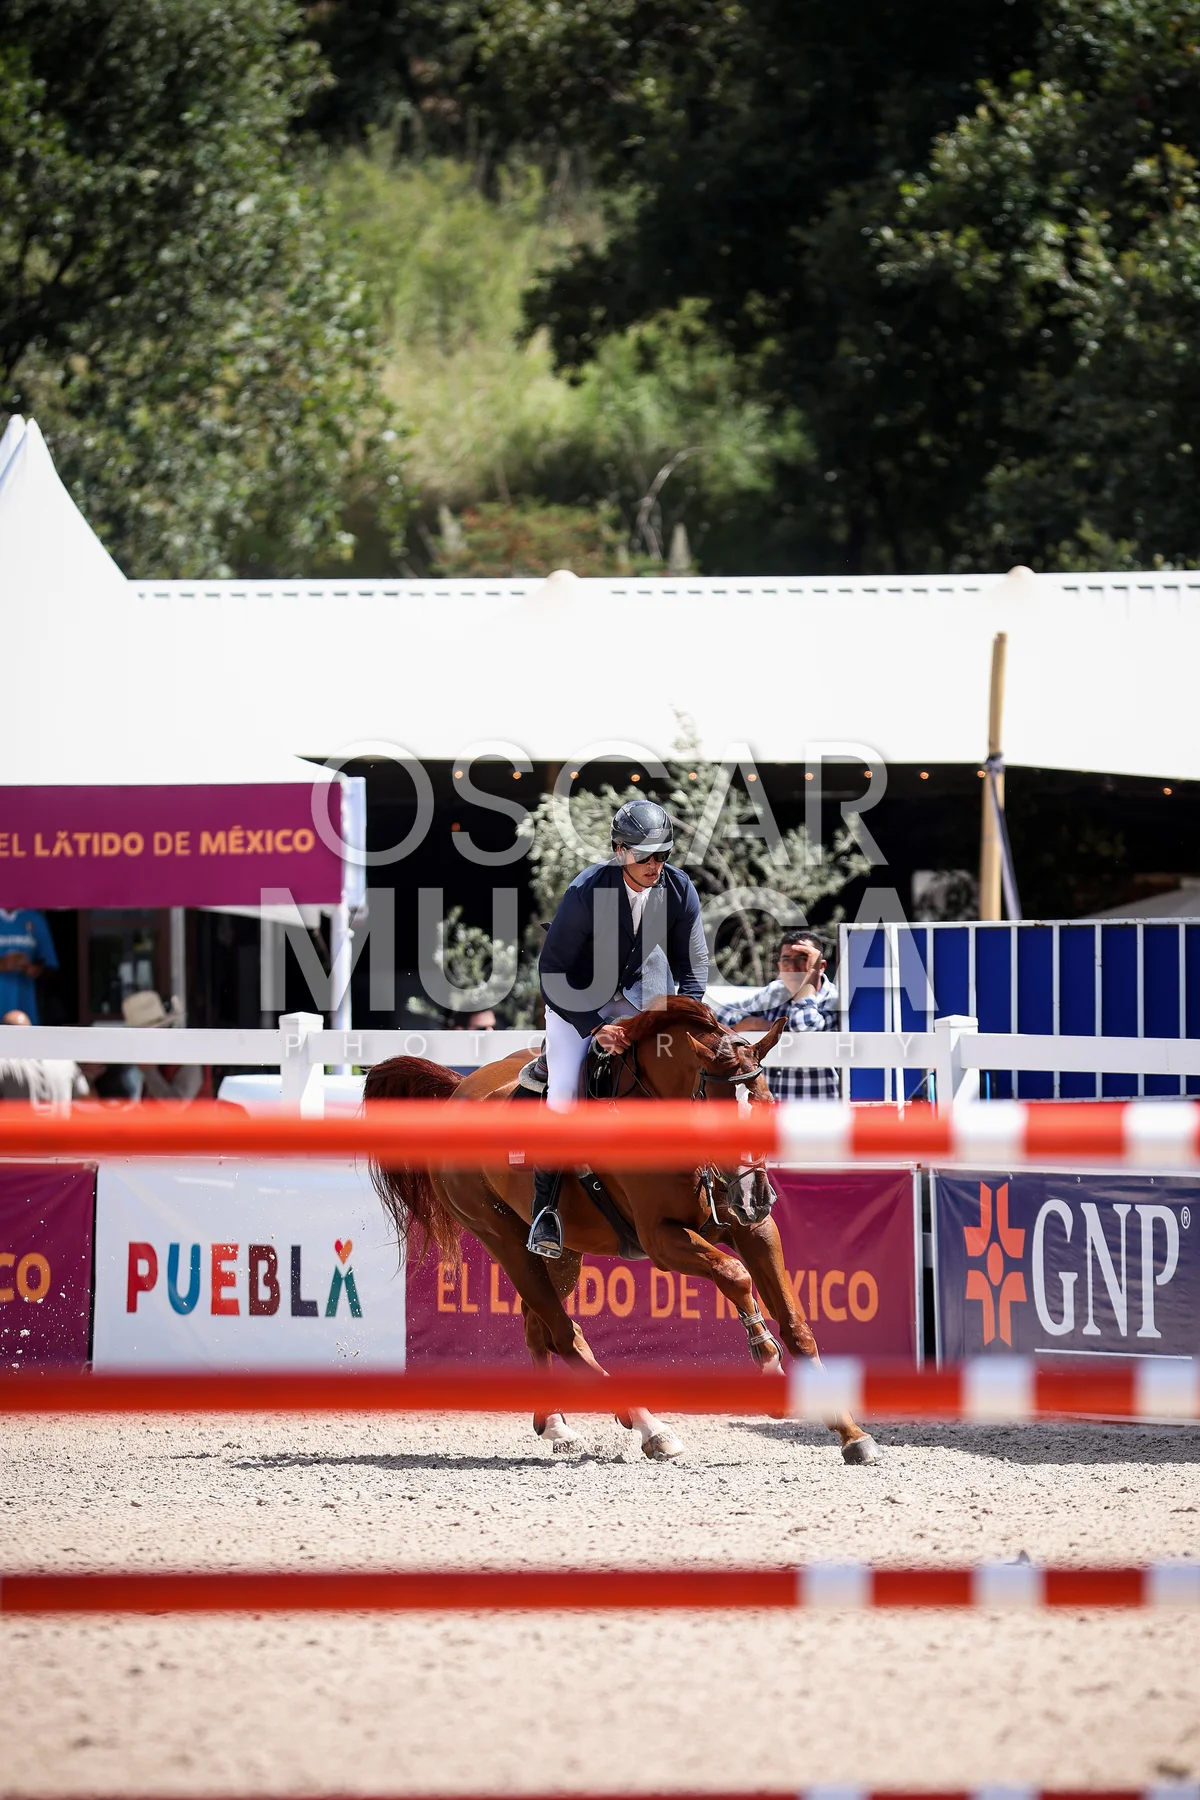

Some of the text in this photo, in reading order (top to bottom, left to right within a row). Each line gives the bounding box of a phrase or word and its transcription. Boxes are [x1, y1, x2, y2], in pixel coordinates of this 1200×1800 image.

[0, 832, 26, 857] EL
[153, 831, 191, 856] DE
[200, 825, 315, 855] MÉXICO
[126, 1238, 363, 1318] PUEBLA
[650, 1266, 700, 1318] DE
